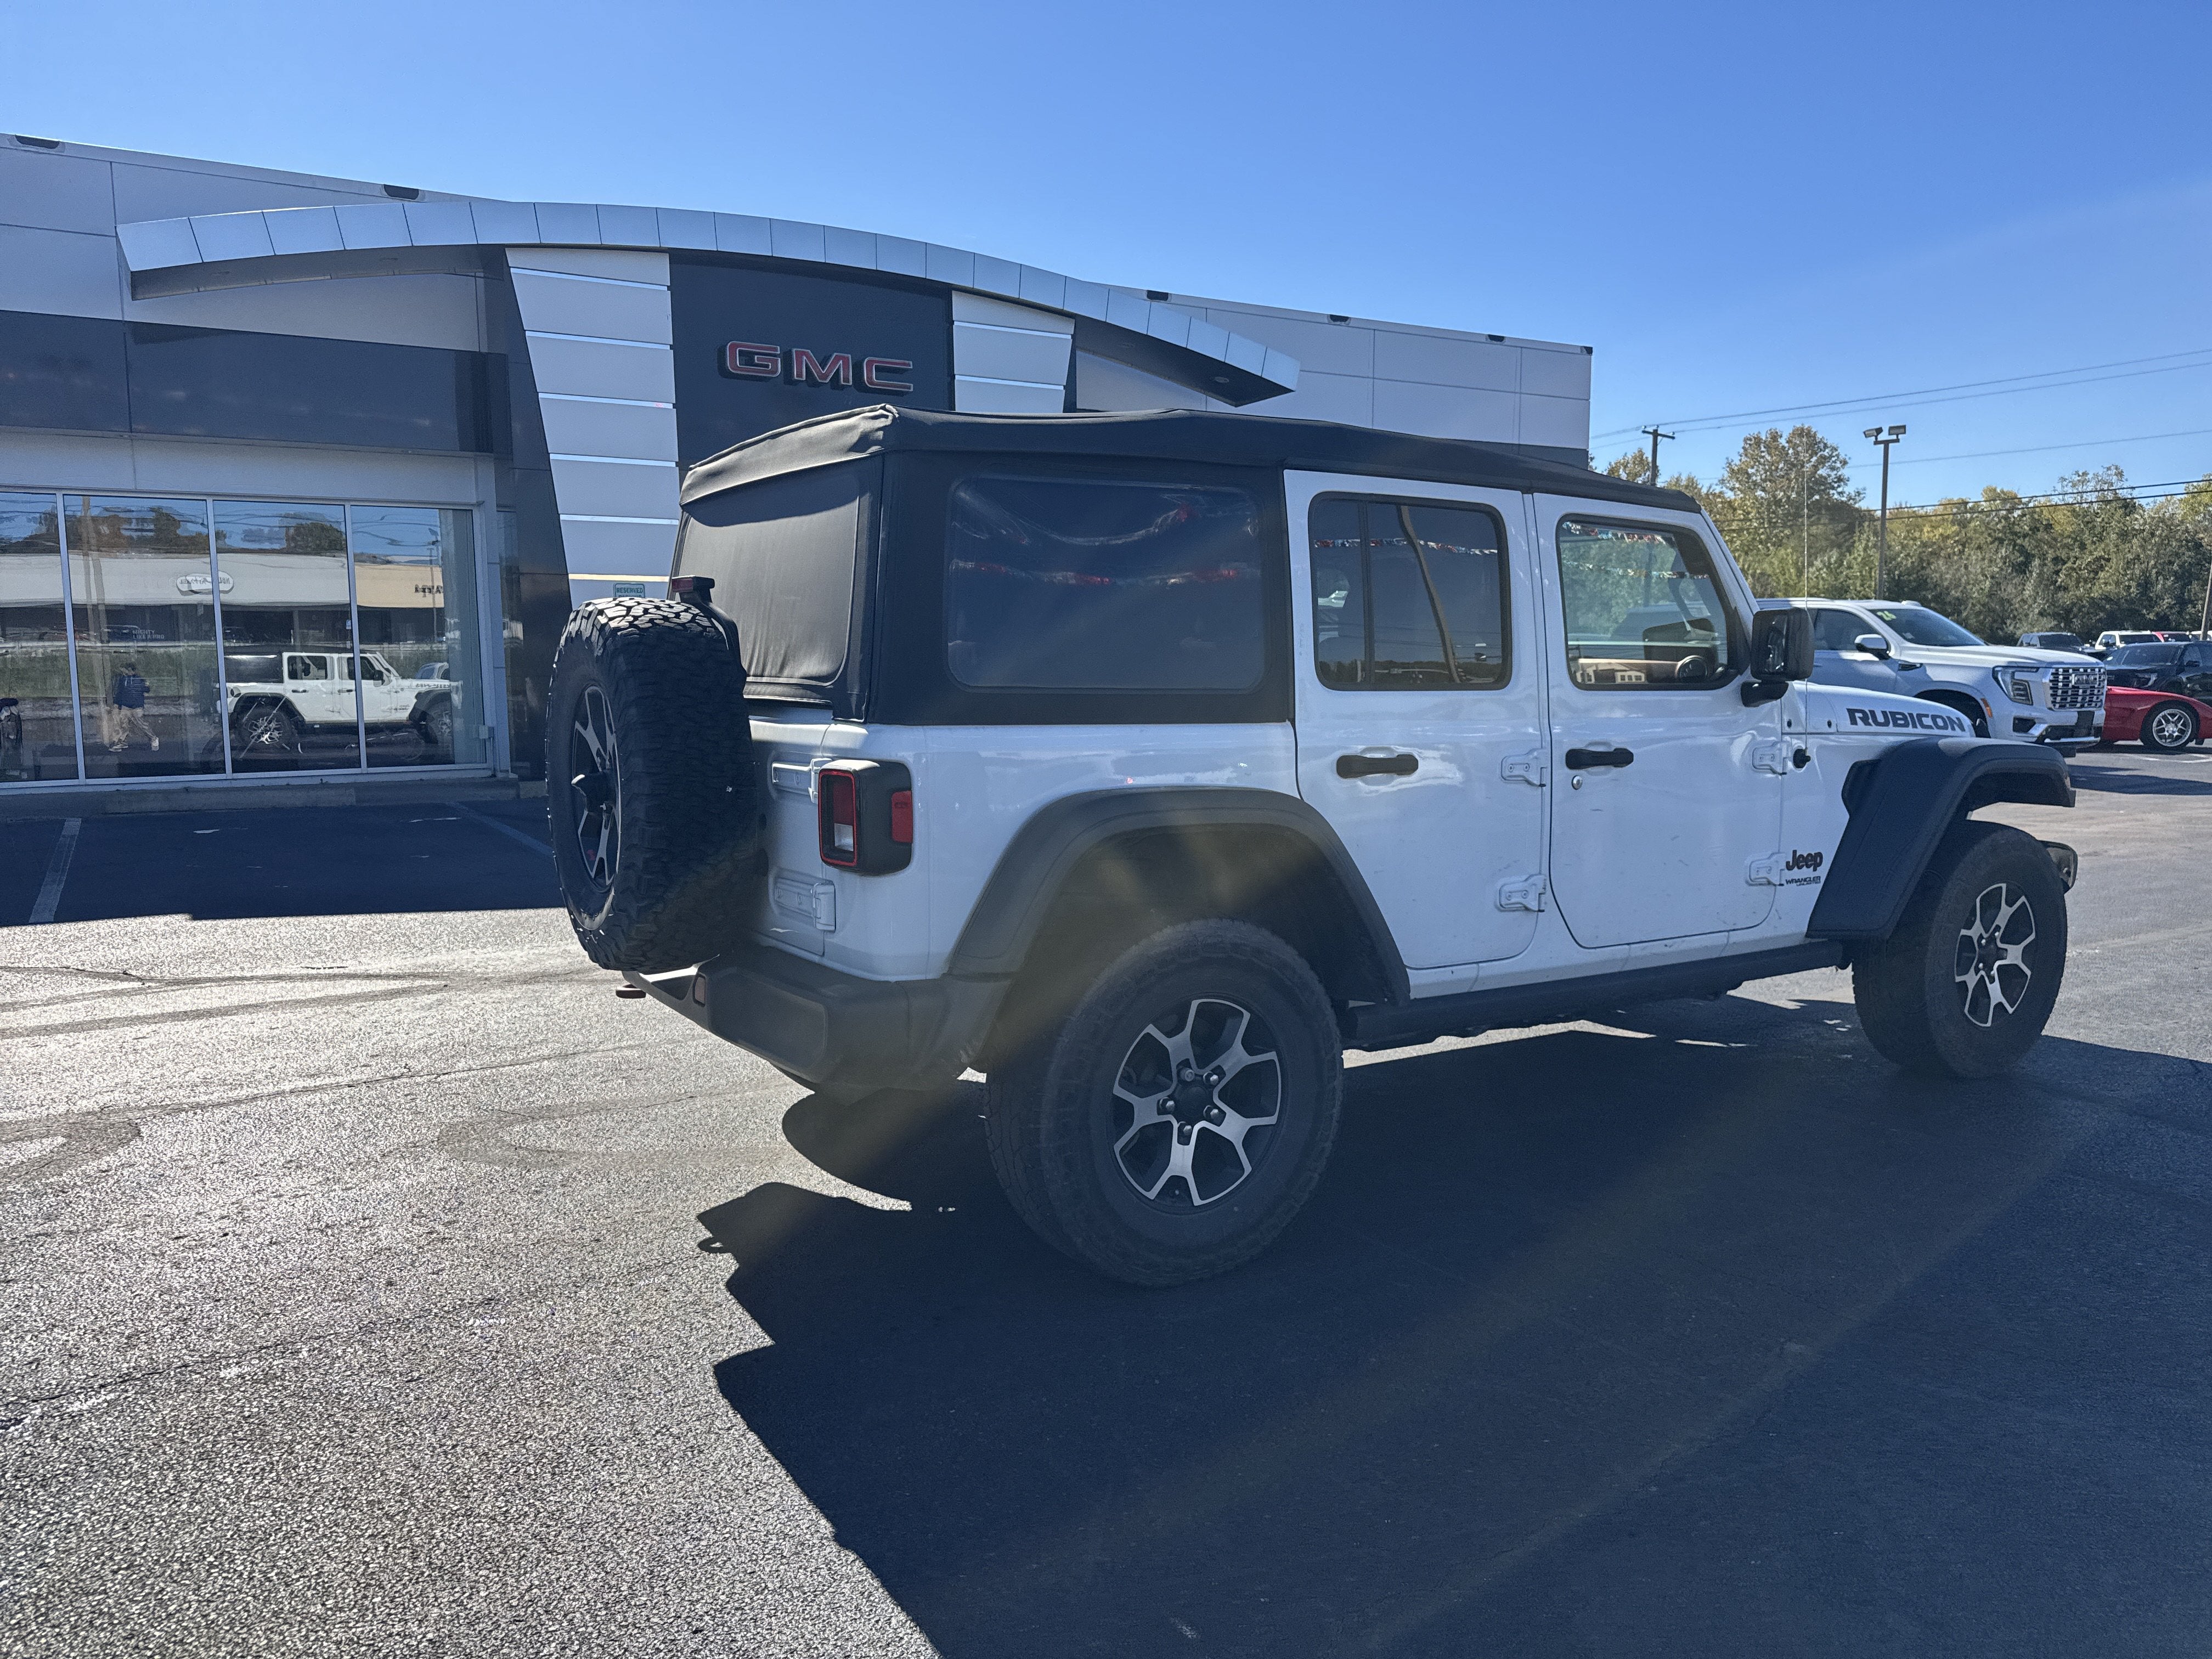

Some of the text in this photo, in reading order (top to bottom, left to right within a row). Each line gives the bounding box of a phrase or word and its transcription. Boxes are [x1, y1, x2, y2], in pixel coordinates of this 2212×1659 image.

[726, 341, 913, 392] GMC
[1846, 708, 1966, 732] RUBICON
[1785, 849, 1824, 872] Jeep
